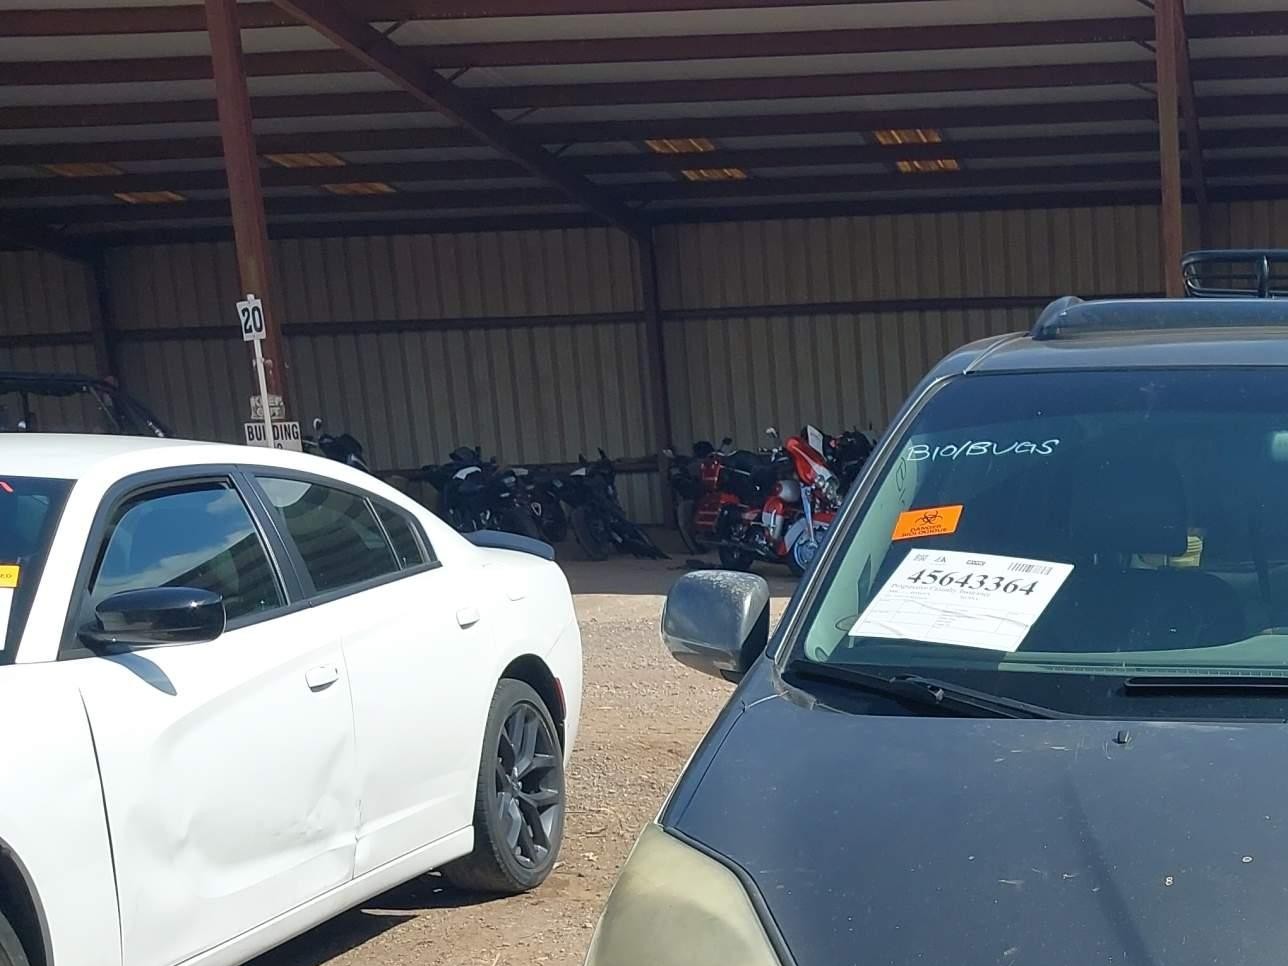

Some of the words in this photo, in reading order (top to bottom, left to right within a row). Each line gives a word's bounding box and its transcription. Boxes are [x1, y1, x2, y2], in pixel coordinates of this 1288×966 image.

[241, 306, 263, 334] 20
[247, 424, 299, 441] BUIDING
[907, 440, 1060, 461] BIO/BUGS
[907, 568, 1039, 596] 45643364
